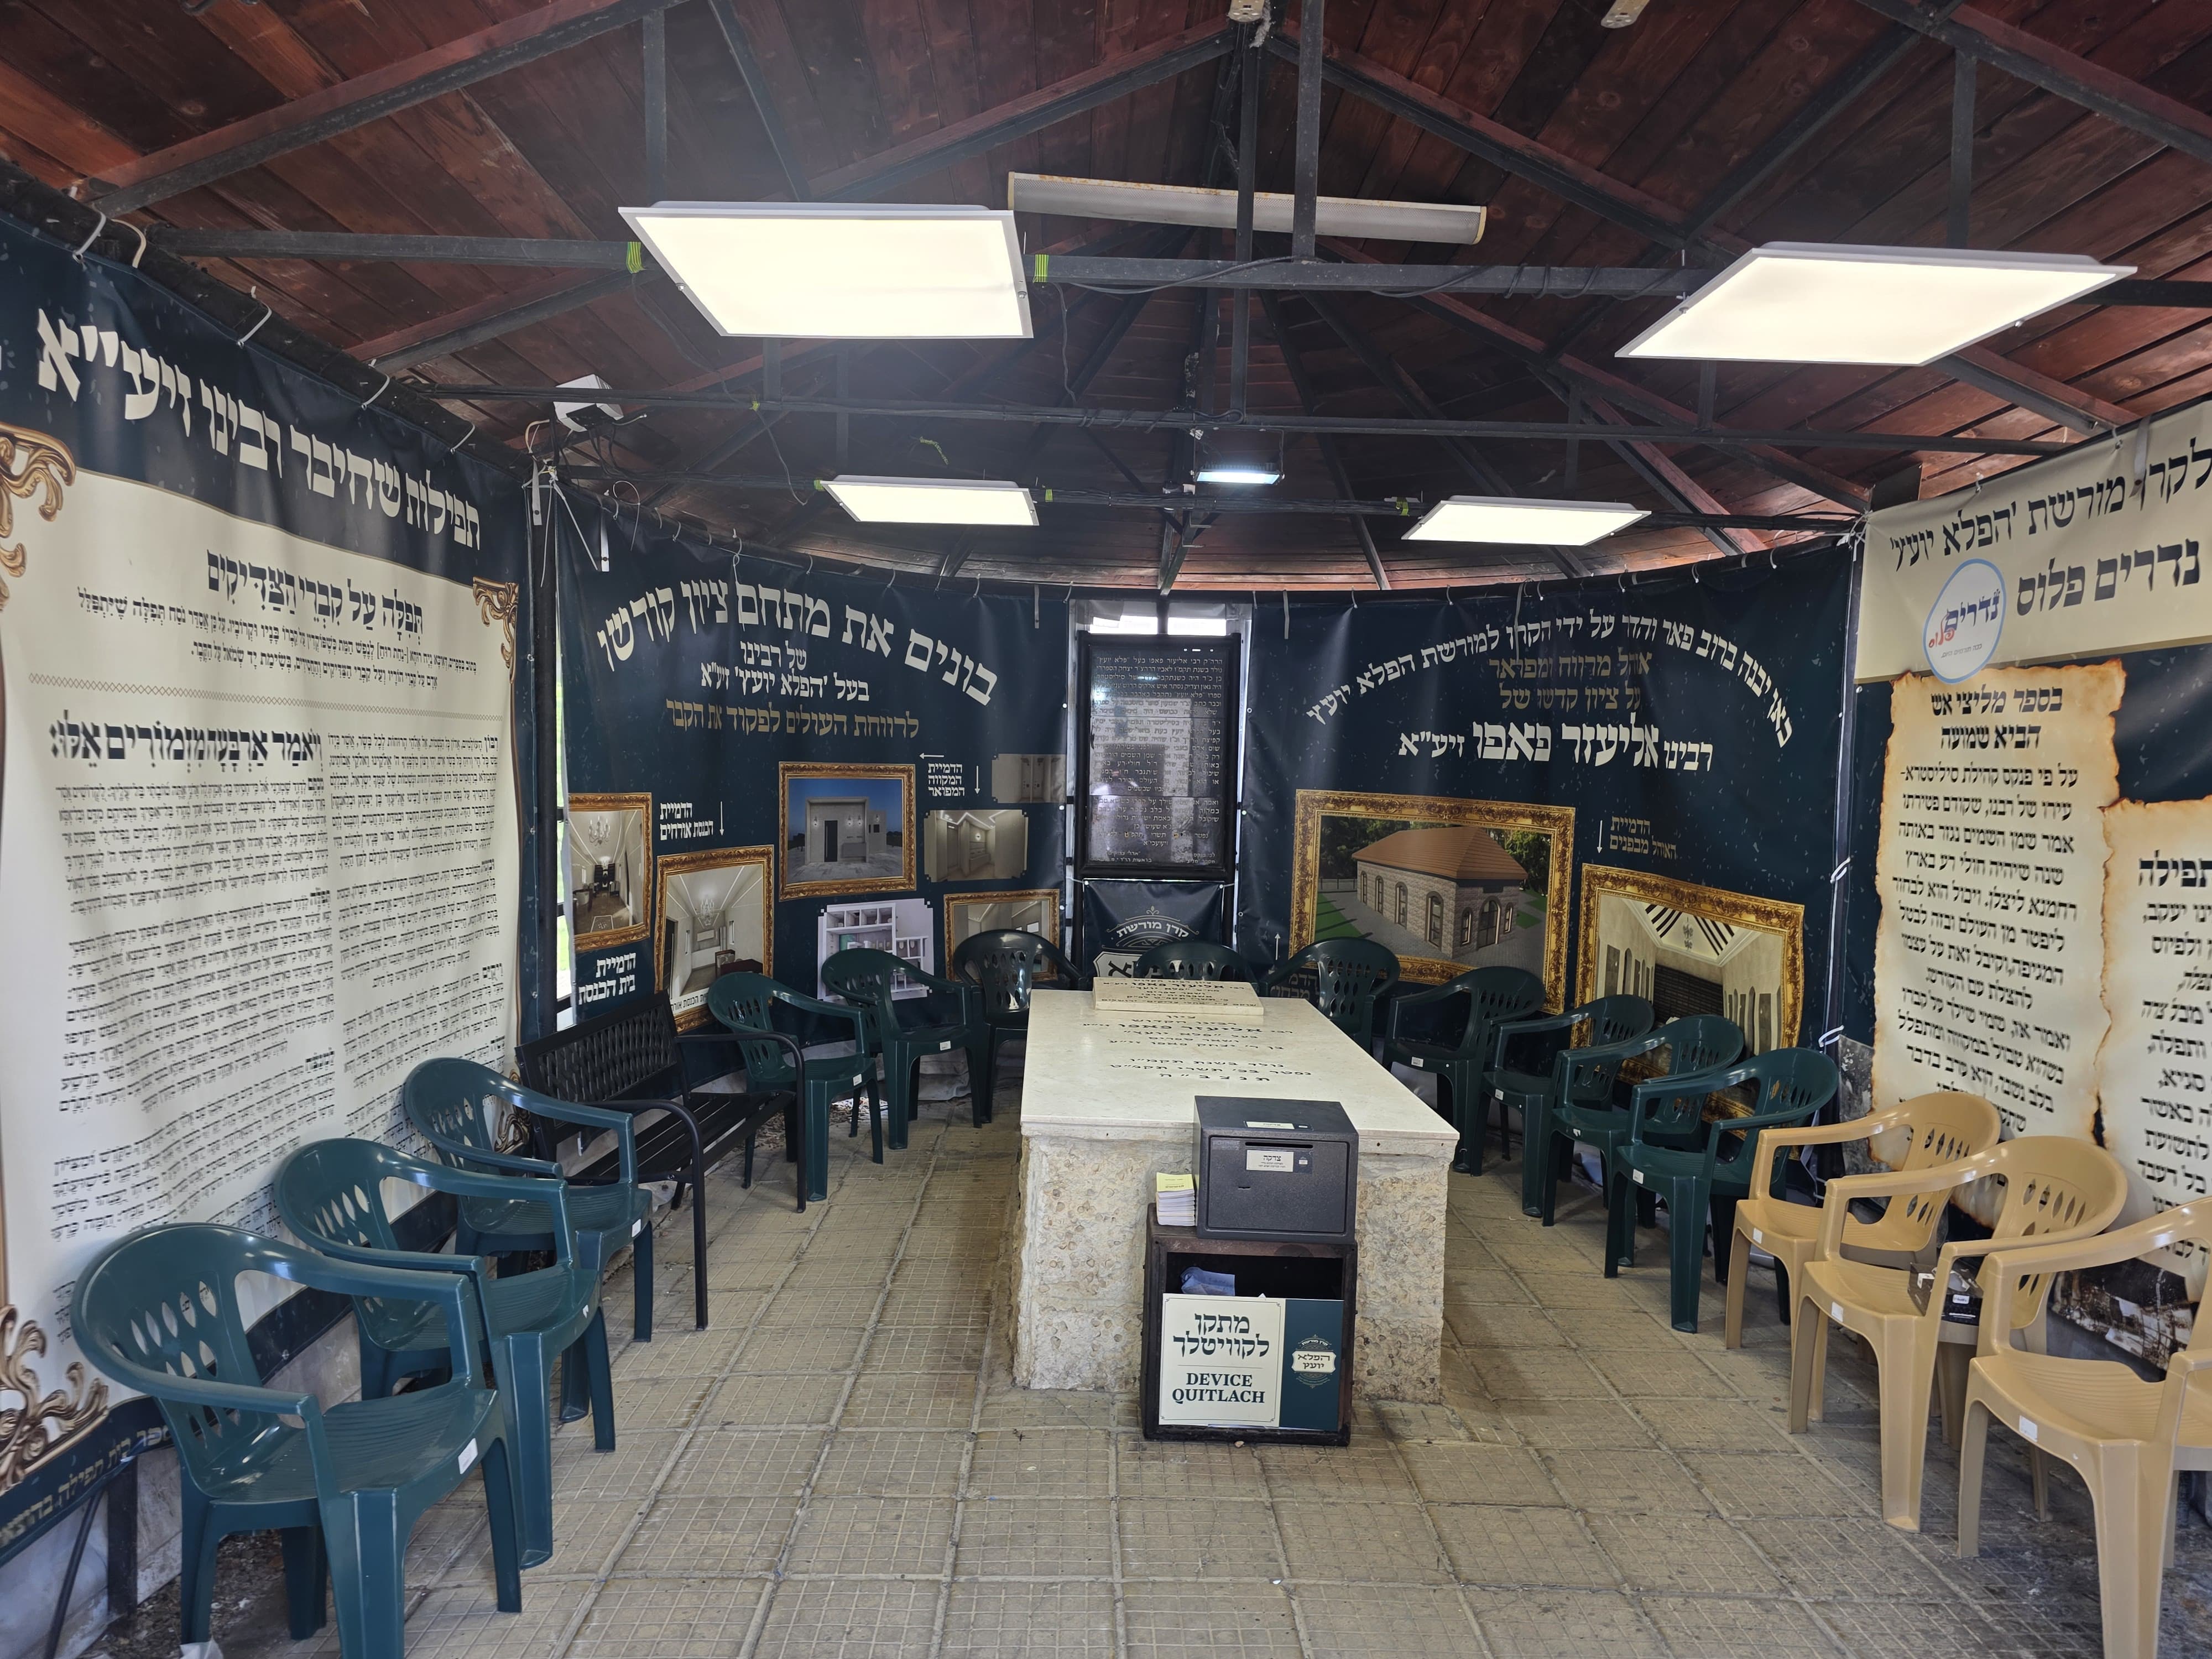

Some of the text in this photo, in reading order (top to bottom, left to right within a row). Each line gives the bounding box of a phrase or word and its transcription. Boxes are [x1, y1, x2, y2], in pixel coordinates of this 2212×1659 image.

[200, 378, 283, 478] רבינו
[290, 424, 401, 518] שחיבר
[405, 469, 480, 551] תפילות
[2027, 476, 2126, 535] מורשת
[1942, 498, 2016, 556] 'הפלא
[1890, 529, 1934, 572] יועץ'
[2017, 538, 2200, 616] נדרים פלוס
[597, 577, 998, 706] בונים את מתחם ציון קודשו
[740, 640, 807, 671] של רבינו
[1489, 646, 1652, 679] אוהל מרווח ומפואר
[734, 666, 775, 696] יועץ'
[780, 667, 828, 698] 'הפלא
[833, 672, 869, 701] בעל
[1306, 608, 1792, 748] כאן יבנה ברוב פאר והדר על ידי הקרן למורשת הפלא יועץ
[1499, 680, 1640, 713] על ציון קדשו של
[1931, 684, 2063, 716] בספר מליצי אש
[666, 698, 919, 738] לרווחת העולים לפקוד את הקבר
[1473, 721, 1551, 761] פאפו
[1561, 712, 1659, 768] אליעזר
[1941, 725, 2041, 750] הביא שמועה
[1663, 740, 1713, 771] רבינו
[928, 763, 963, 774] הדמיית
[928, 775, 962, 786] המקווה
[1962, 761, 1999, 784] קהילת
[2002, 768, 2033, 785] פנקס
[2038, 769, 2052, 786] פי
[2058, 763, 2078, 788] על
[928, 786, 965, 797] המפואר
[660, 802, 692, 820] הדמיית
[2017, 794, 2037, 818] של
[660, 820, 713, 841] הכנסת אורחים
[1610, 816, 1650, 834] הדמיית
[1964, 828, 2005, 846] השמים
[1609, 834, 1677, 859] האוהל מבפנים
[2010, 832, 2036, 850] שמן
[2042, 834, 2074, 853] אמר
[1939, 854, 1955, 870] רע
[2035, 866, 2063, 885] שנה
[1928, 883, 1948, 897] הוא
[2028, 896, 2077, 921] רחמנא
[1117, 921, 1189, 937] קרן מורשת
[596, 952, 637, 978] הדמיית
[578, 974, 635, 1005] בית הכנסת
[1194, 1313, 1250, 1335] מתקן
[1173, 1331, 1269, 1359] לקוויטלך
[1186, 1373, 1253, 1387] DEVICE
[1172, 1388, 1265, 1405] QUITLACH
